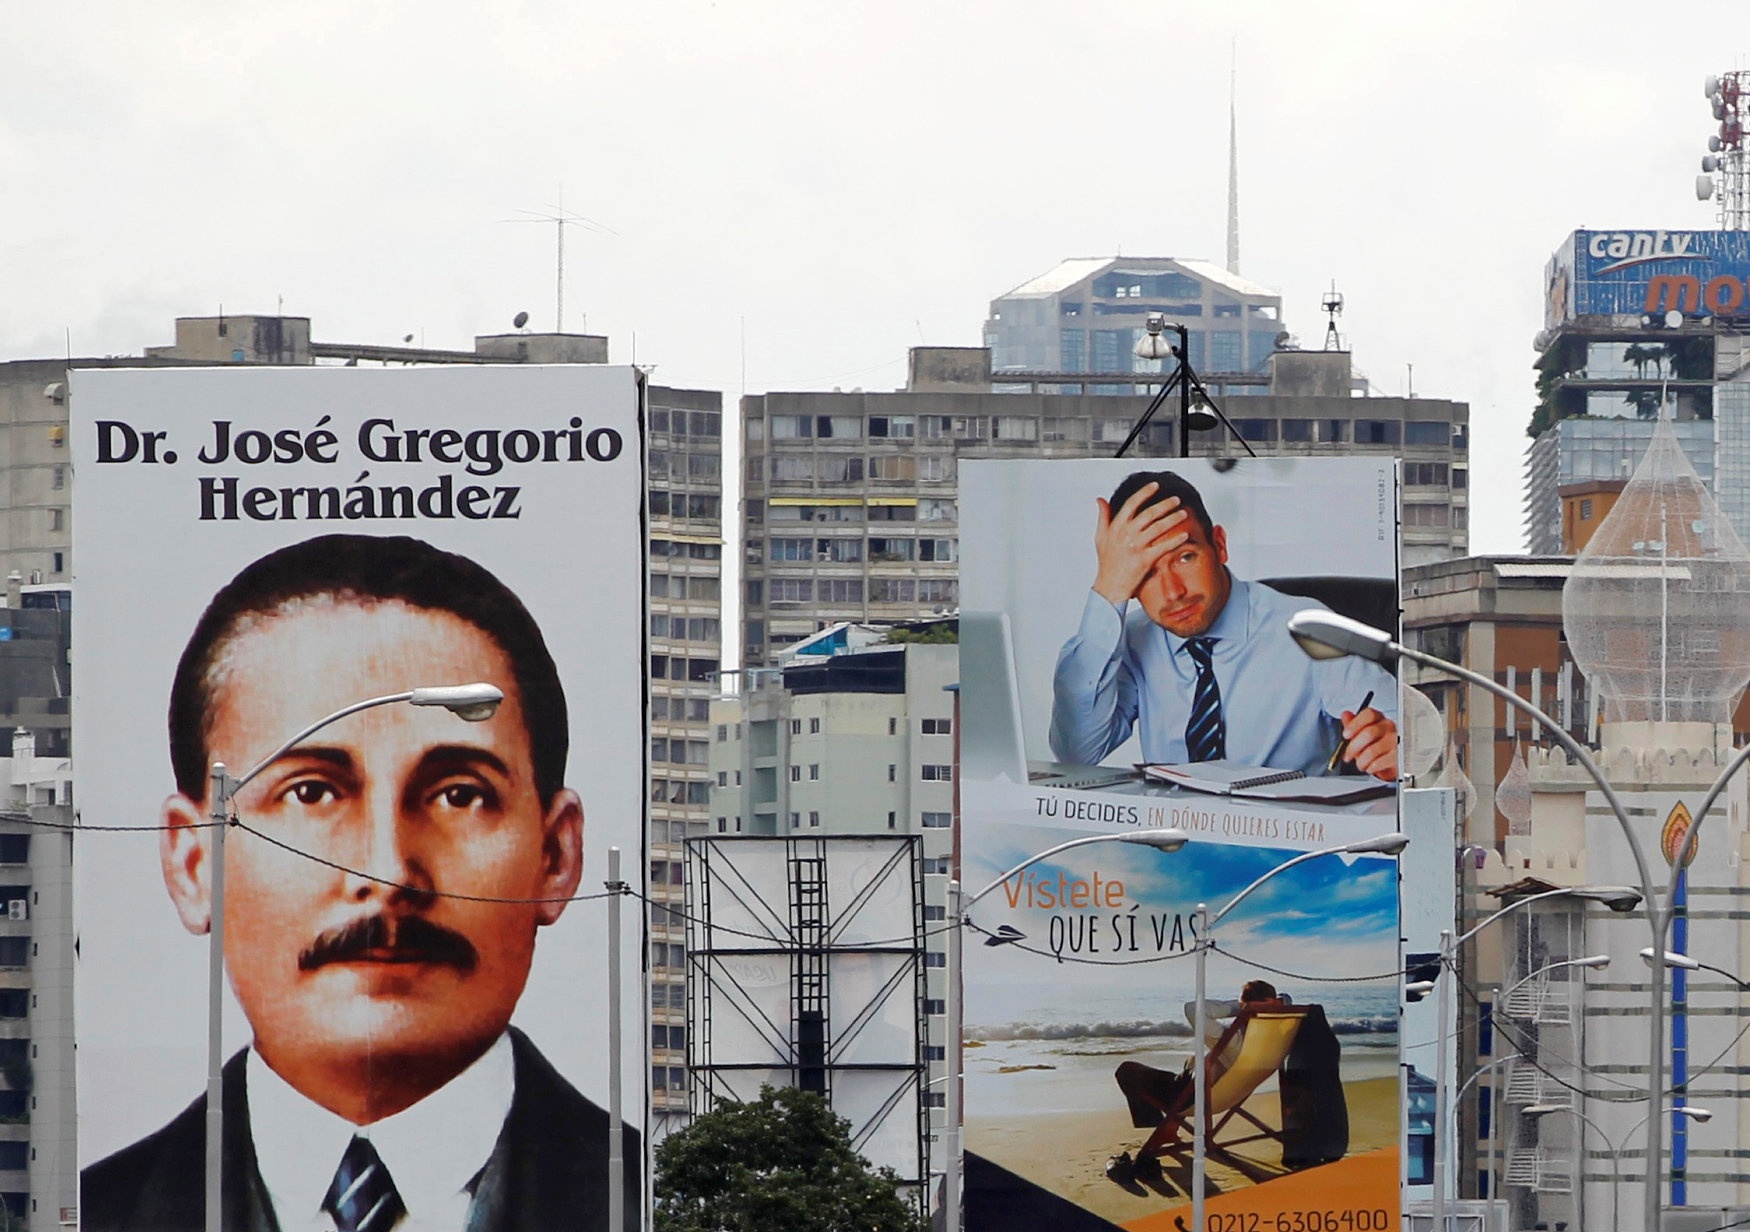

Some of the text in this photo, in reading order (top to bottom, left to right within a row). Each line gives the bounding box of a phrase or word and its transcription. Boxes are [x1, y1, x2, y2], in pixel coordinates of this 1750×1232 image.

[95, 416, 622, 475] Dr. José Gregorio
[199, 471, 521, 520] Hernández
[1036, 797, 1325, 842] TÚ DECIDES, EN DÓNDE QUIERES ESTAR
[1000, 871, 1125, 909] Vístete
[1050, 904, 1198, 963] QUE SÍ VAS
